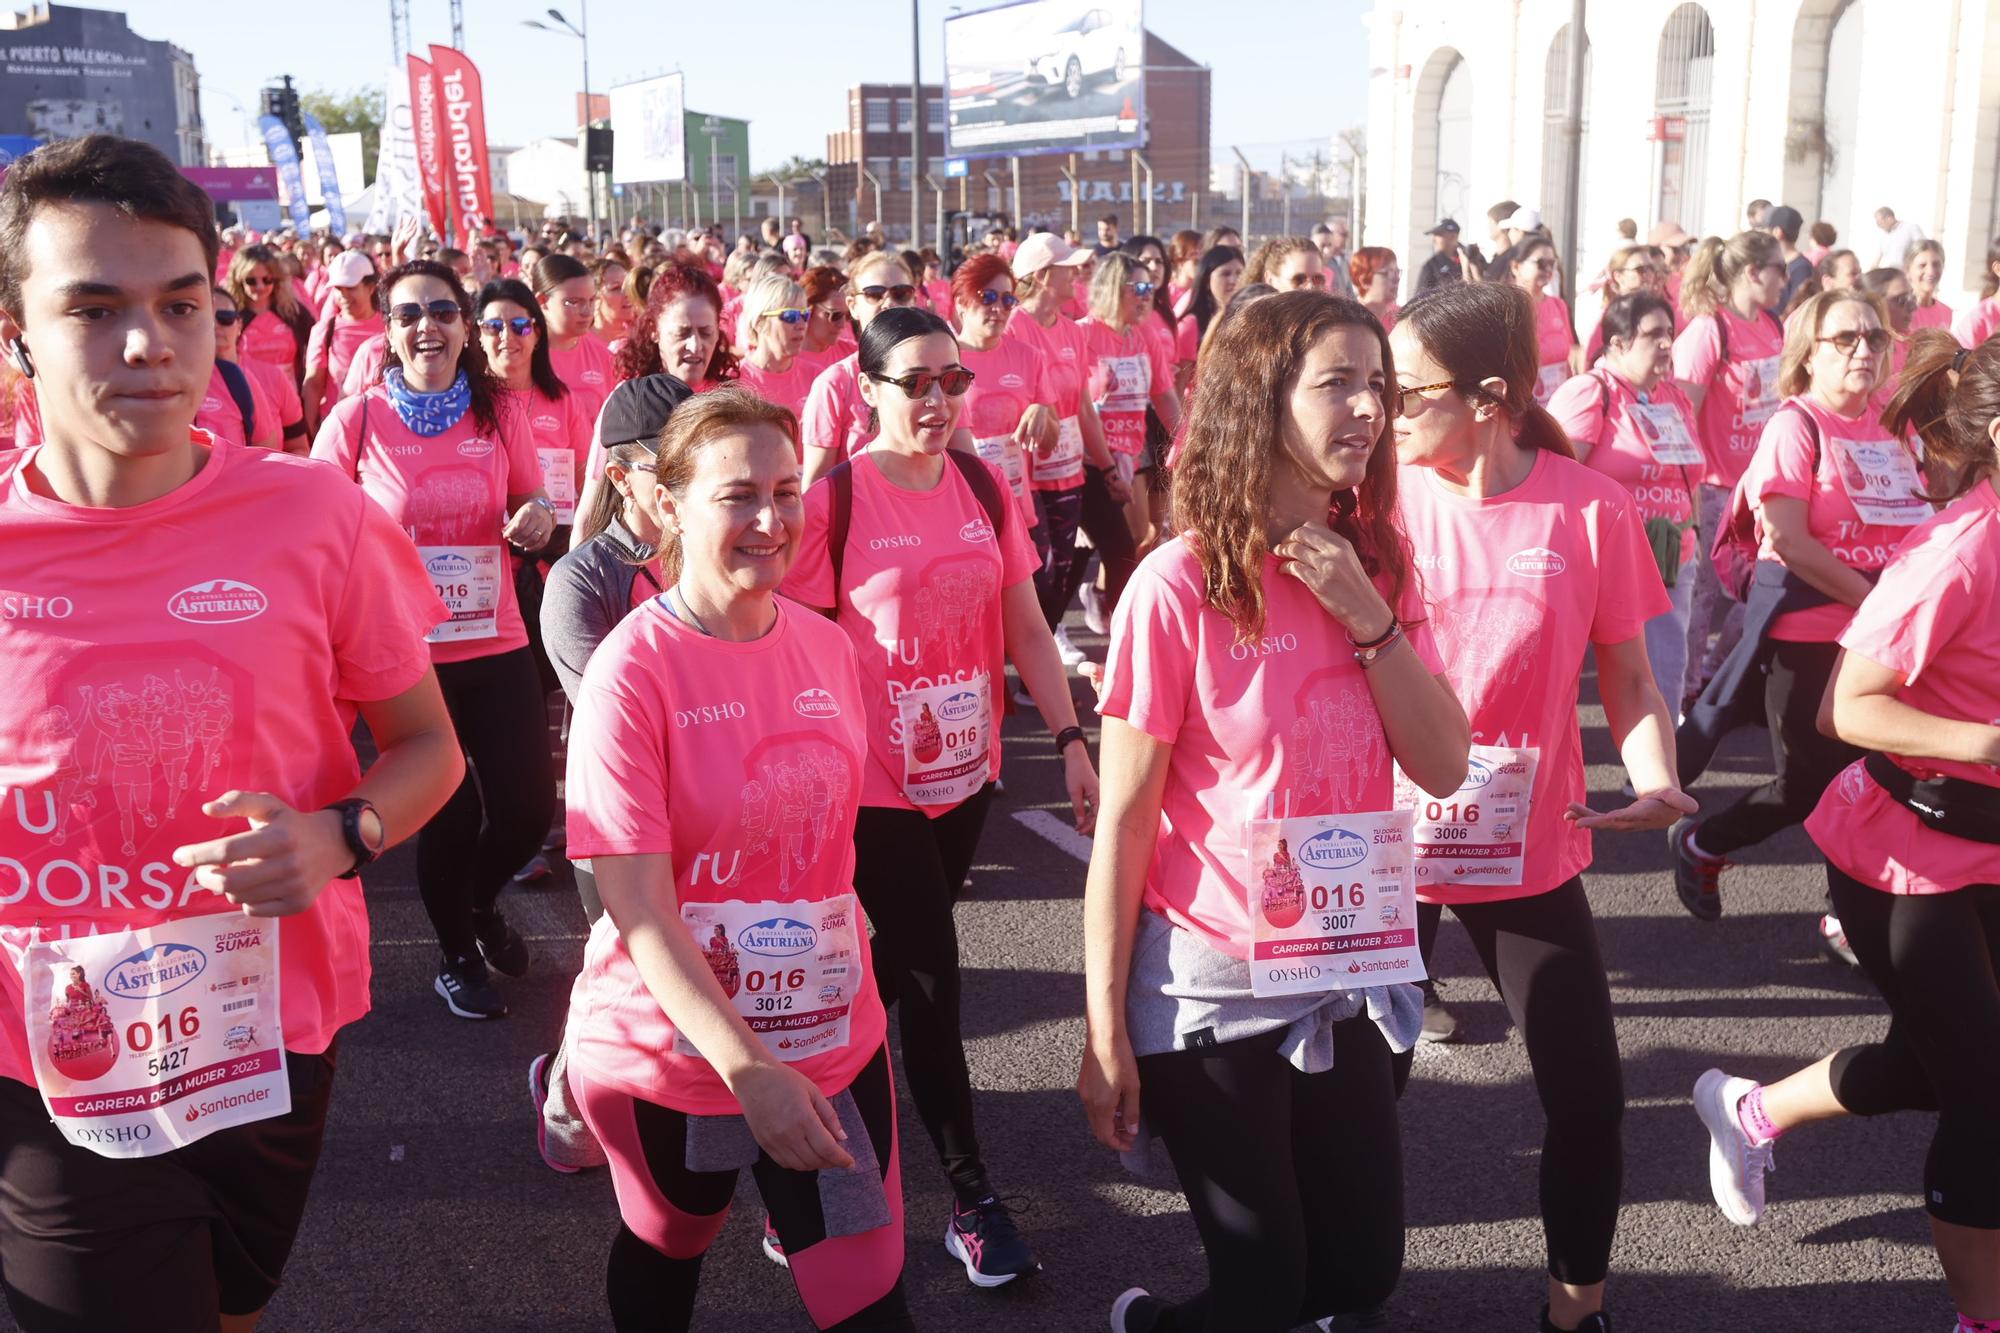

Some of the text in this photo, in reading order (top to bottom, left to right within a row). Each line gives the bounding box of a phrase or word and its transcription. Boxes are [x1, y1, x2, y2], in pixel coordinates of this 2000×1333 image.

[443, 68, 485, 231] Santander
[1641, 463, 1664, 480] TU
[1865, 473, 1892, 488] 016
[870, 535, 922, 551] OYSHO
[430, 562, 469, 572] ASTURIANA
[1511, 558, 1562, 570] ASTURIANA
[176, 597, 261, 615] ASTURIANA
[881, 637, 920, 667] TU
[1230, 633, 1297, 660] OYSHO
[675, 701, 745, 728] OYSHO
[945, 726, 977, 749] 016
[954, 748, 972, 762] 1934
[920, 770, 953, 782] CARRERA
[1498, 766, 1527, 775] SUMA
[916, 786, 954, 798] OYSHO
[1425, 801, 1480, 823] 016
[1373, 834, 1403, 845] SUMA
[1434, 827, 1468, 840] 3006
[1305, 845, 1364, 860] ASTURIANA
[1459, 848, 1490, 856] MUJER
[1466, 864, 1513, 875] Santander
[1311, 883, 1365, 910] 016
[821, 918, 846, 932] SUMA
[1322, 914, 1356, 931] 3007
[227, 928, 262, 940] DORSAL
[745, 932, 814, 948] ASTURIANA
[215, 935, 262, 953] SUMA
[1272, 934, 1403, 955] CARRERA DE LA MUJER 2023
[1269, 965, 1321, 982] OYSHO
[1361, 959, 1410, 973] Santander
[114, 958, 200, 992] ASTURIANA
[745, 968, 806, 992] 016
[755, 996, 792, 1011] 3012
[126, 1006, 200, 1052] 016
[752, 1020, 768, 1029] DE
[770, 1020, 782, 1028] LA
[785, 1016, 818, 1027] MUJER
[793, 1027, 838, 1049] Santander
[148, 1047, 189, 1077] 5427
[75, 1058, 261, 1113] CARRERA DE LA MUJER 2023
[200, 1088, 270, 1117] Santander
[77, 1124, 151, 1143] OYSHO
